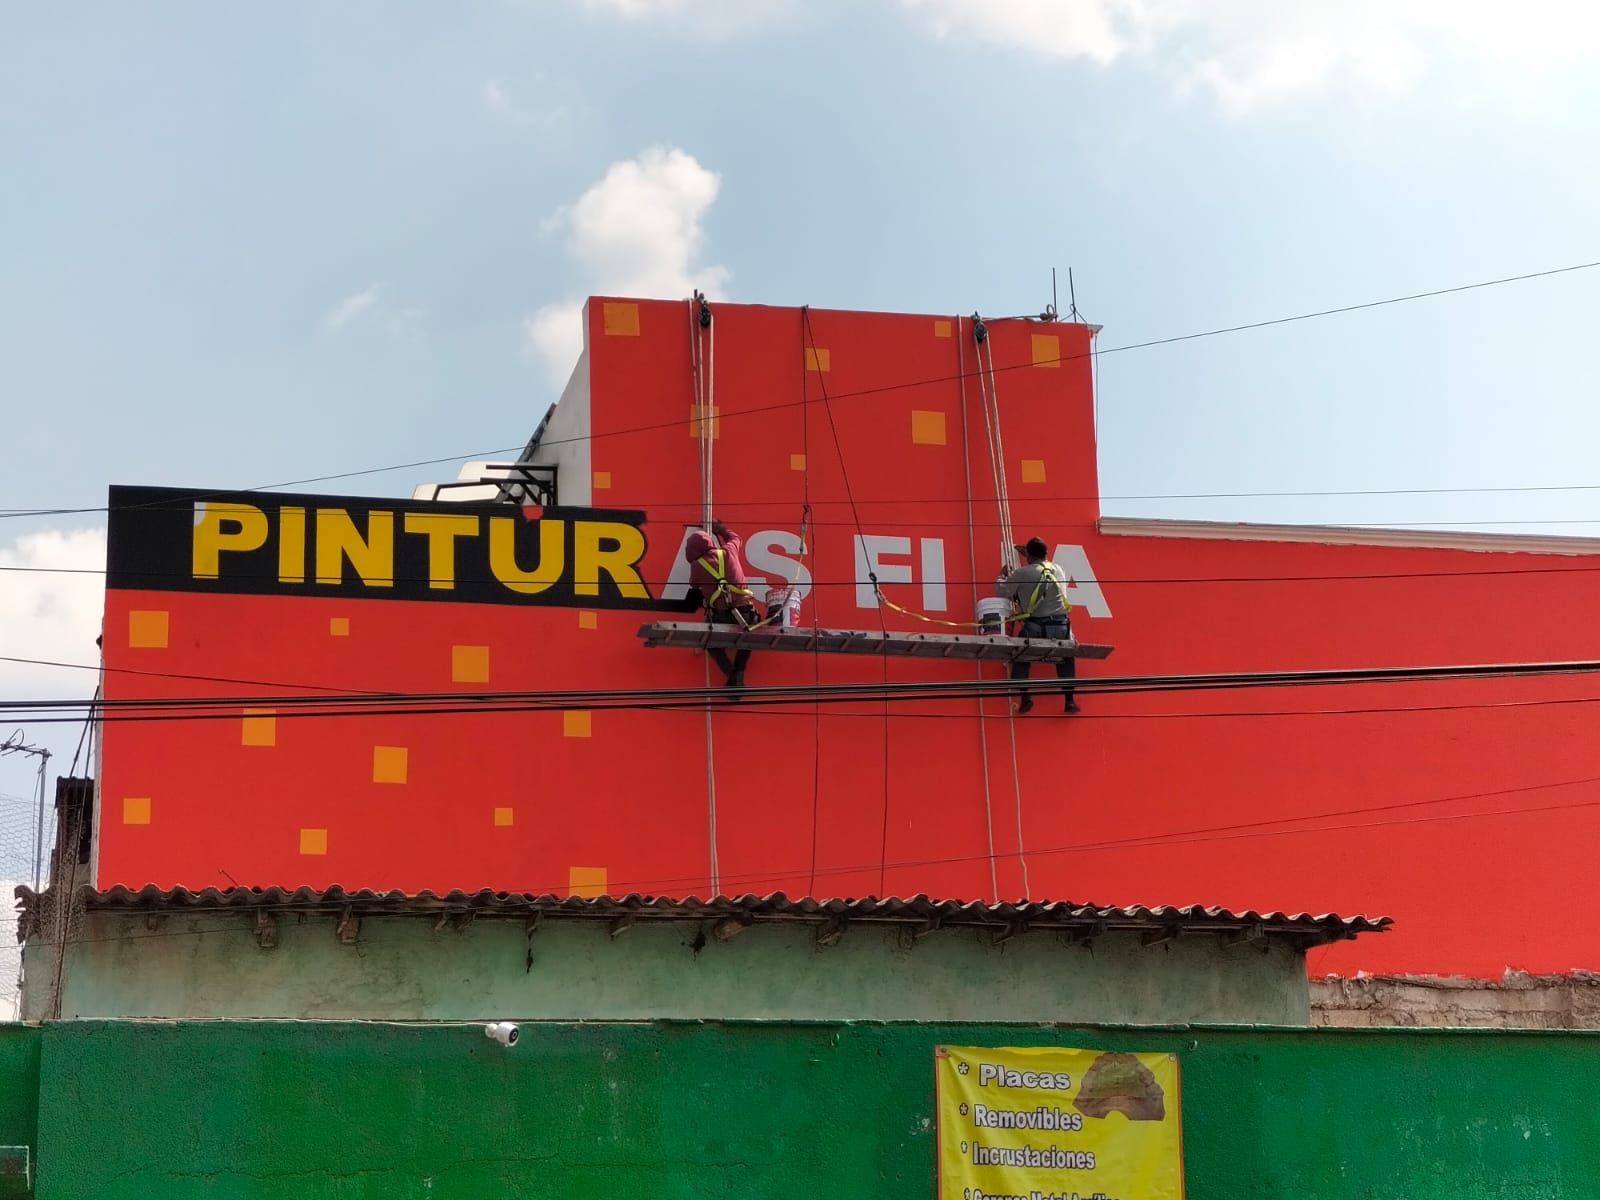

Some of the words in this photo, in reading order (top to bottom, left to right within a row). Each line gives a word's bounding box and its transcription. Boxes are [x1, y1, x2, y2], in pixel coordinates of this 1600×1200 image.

[979, 1064, 1071, 1090] Placas
[975, 1104, 1082, 1131] Removibles
[972, 1142, 1095, 1169] Incrustaciones
